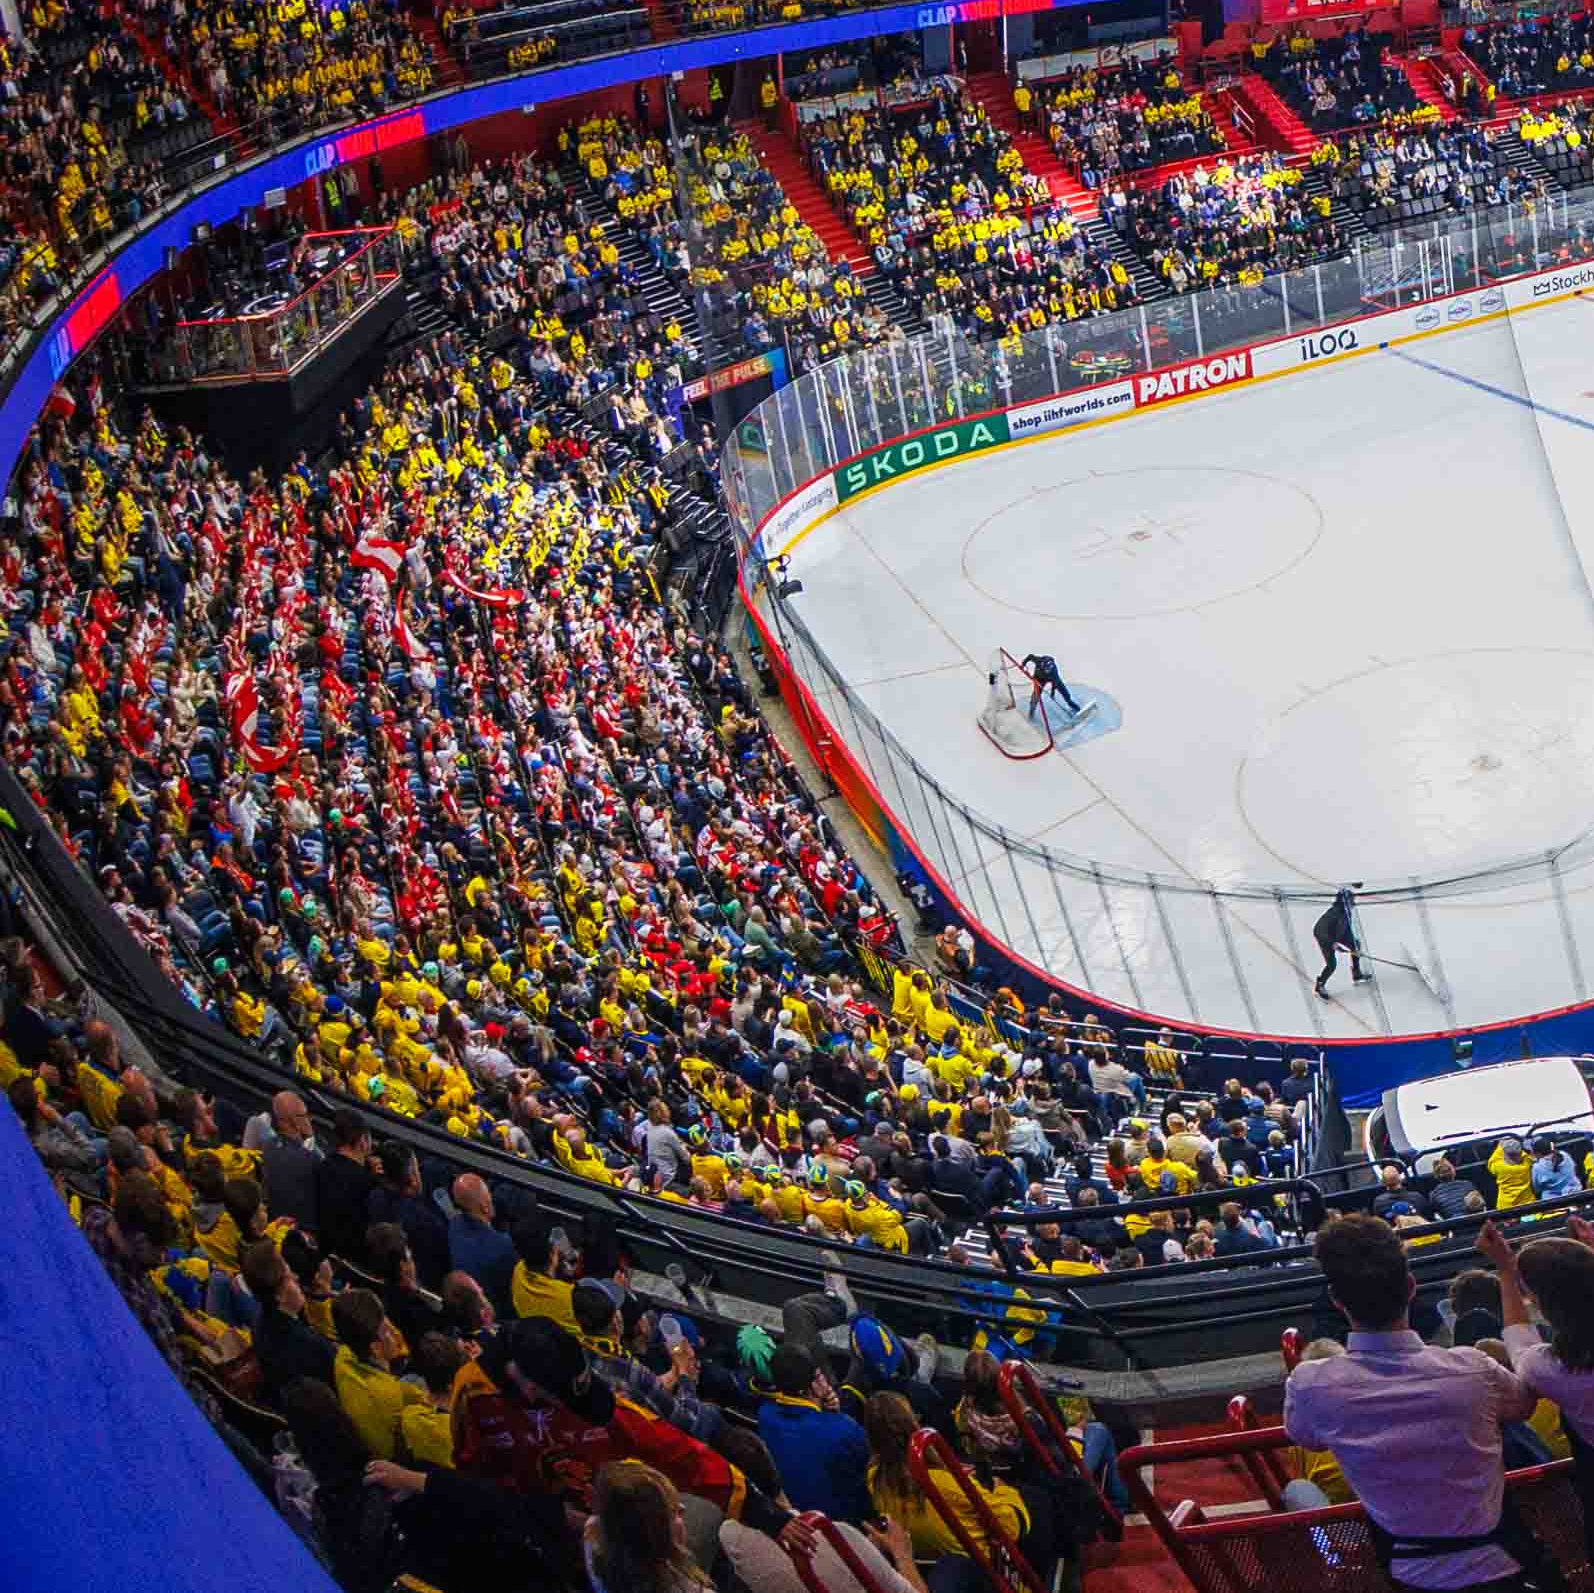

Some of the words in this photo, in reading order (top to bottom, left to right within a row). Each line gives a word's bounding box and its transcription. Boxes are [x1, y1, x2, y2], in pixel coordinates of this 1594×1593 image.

[917, 6, 957, 28] CLAP
[1302, 329, 1359, 361] iLOQ
[1140, 353, 1246, 403] PATRON
[846, 422, 995, 493] SKODA
